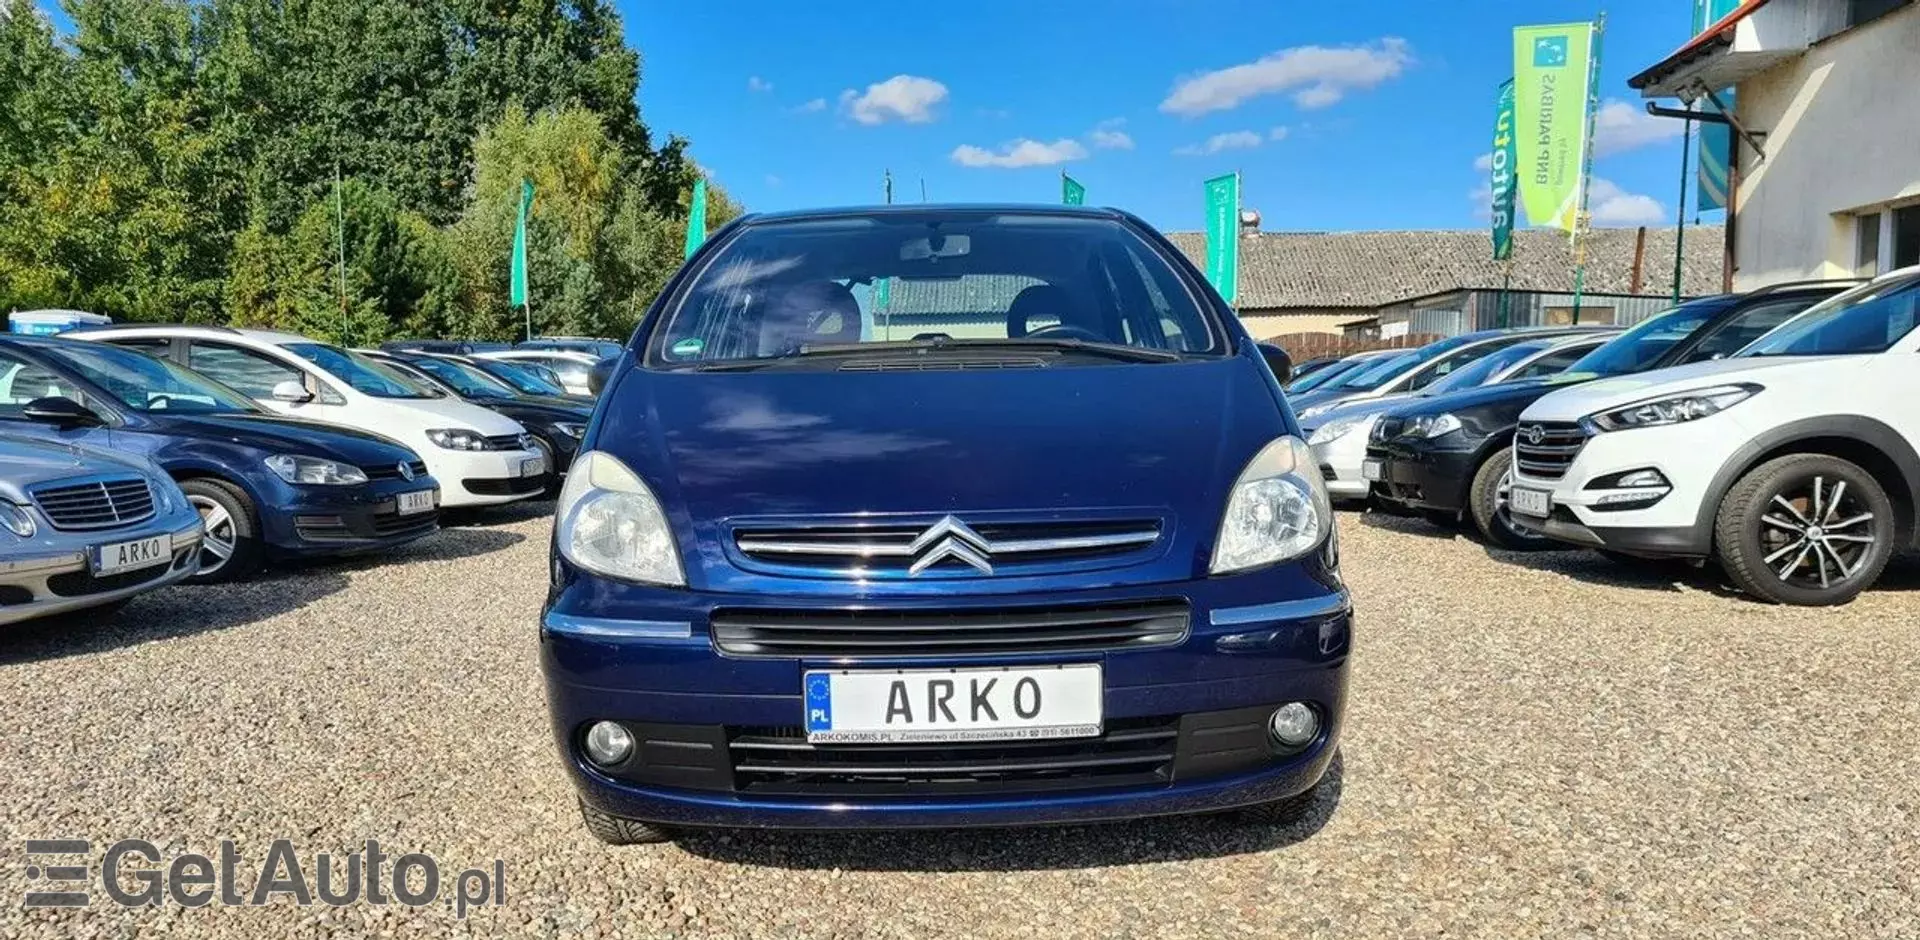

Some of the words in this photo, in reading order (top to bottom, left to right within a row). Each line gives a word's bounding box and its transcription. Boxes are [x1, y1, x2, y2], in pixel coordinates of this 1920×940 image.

[118, 539, 160, 565] ARKO
[885, 676, 1042, 724] ARKO
[811, 709, 829, 722] PL
[813, 733, 892, 742] ARKOKOMIS.PL
